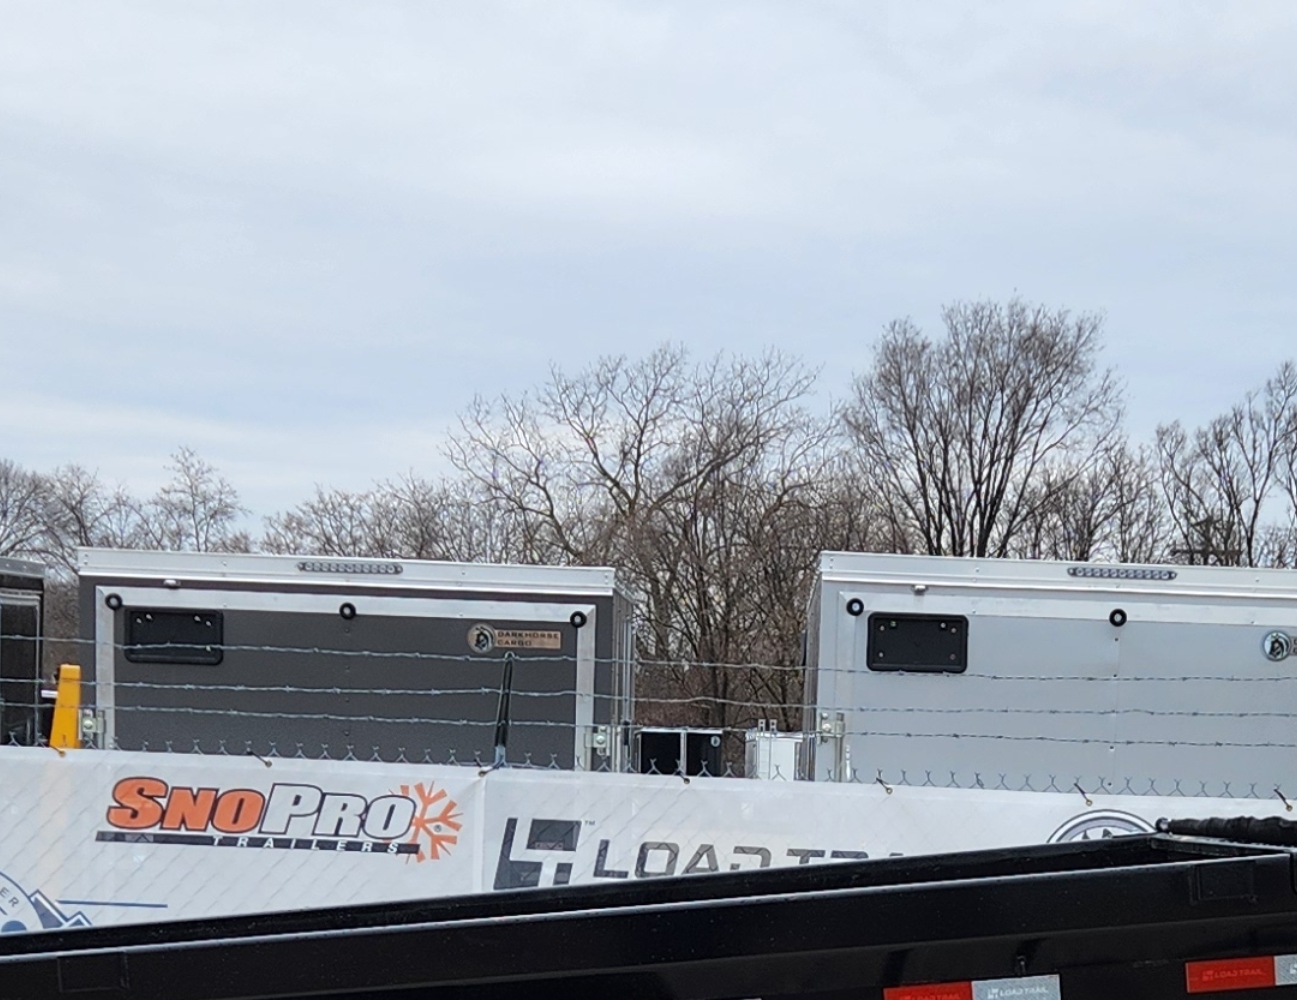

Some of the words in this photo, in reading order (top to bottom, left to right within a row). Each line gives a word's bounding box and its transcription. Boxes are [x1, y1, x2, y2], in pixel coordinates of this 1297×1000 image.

[497, 631, 560, 640] DARKHORSE
[212, 835, 400, 854] TRAILERS
[1000, 988, 1024, 997] LOAD
[1023, 986, 1049, 995] TRAIL
